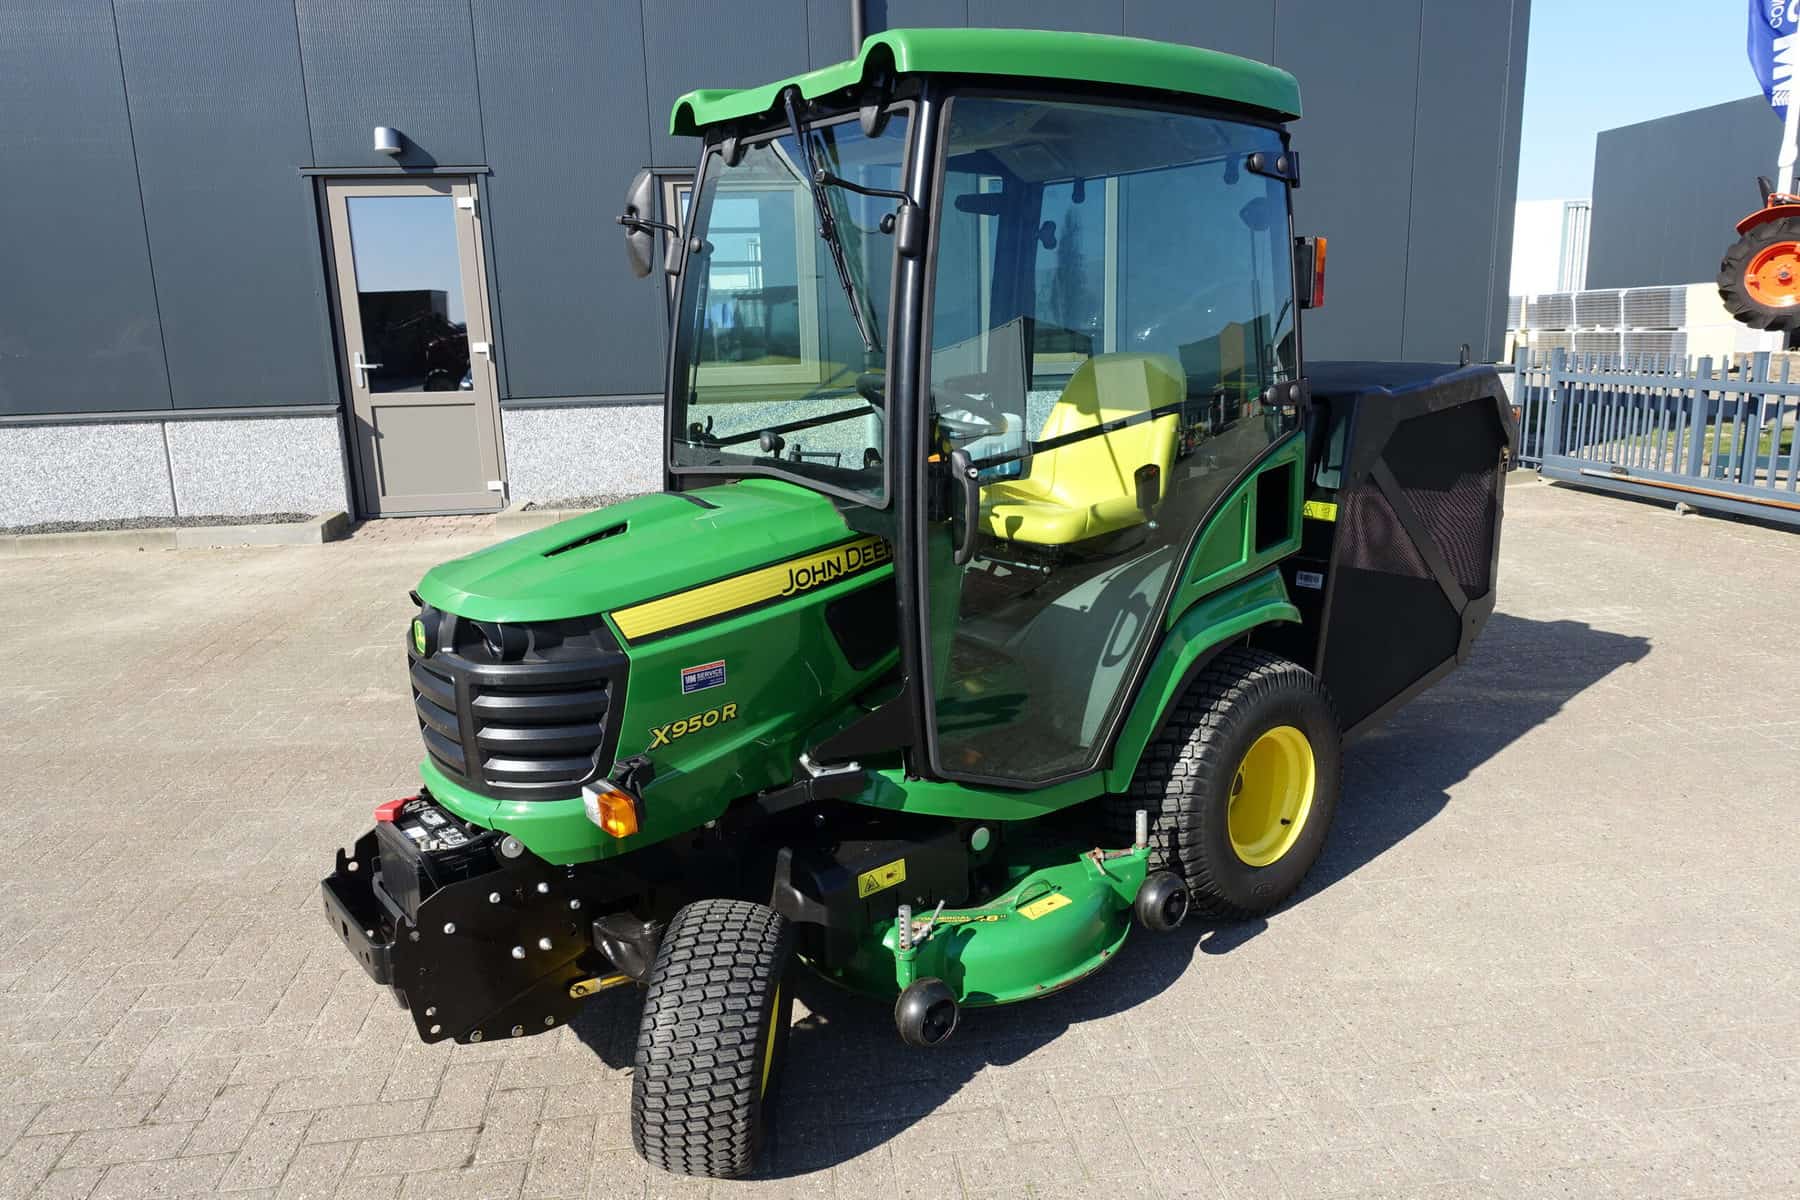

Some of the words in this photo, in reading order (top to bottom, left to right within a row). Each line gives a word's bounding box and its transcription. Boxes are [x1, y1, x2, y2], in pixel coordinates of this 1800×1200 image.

[782, 555, 842, 594] JOHN
[845, 543, 893, 570] DEER
[650, 703, 737, 749] X950R
